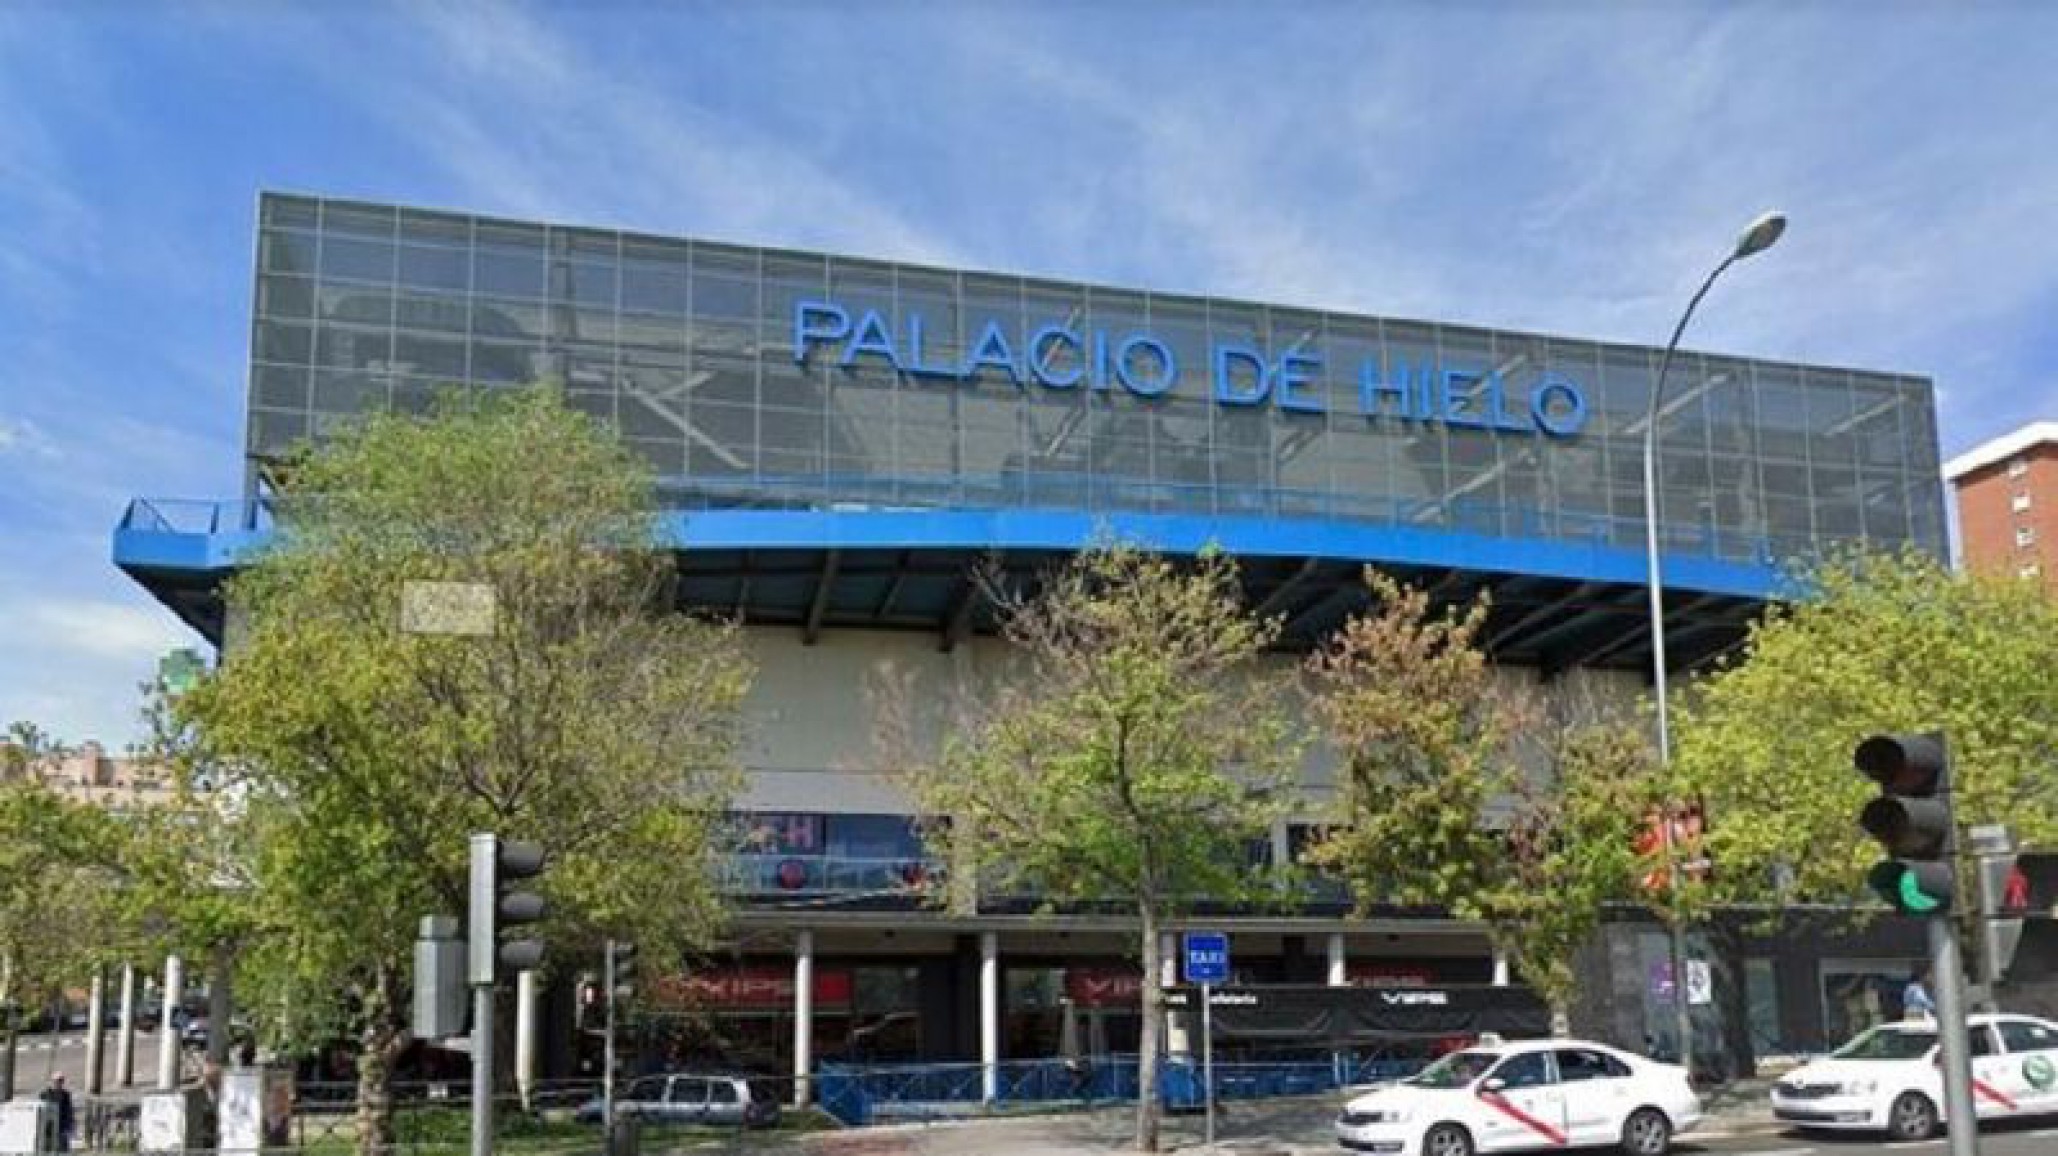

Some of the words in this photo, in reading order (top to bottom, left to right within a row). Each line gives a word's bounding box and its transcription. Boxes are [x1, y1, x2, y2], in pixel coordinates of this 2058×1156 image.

[795, 301, 1178, 397] PALACIO
[1213, 343, 1326, 412] DE
[1357, 355, 1587, 437] HIELO
